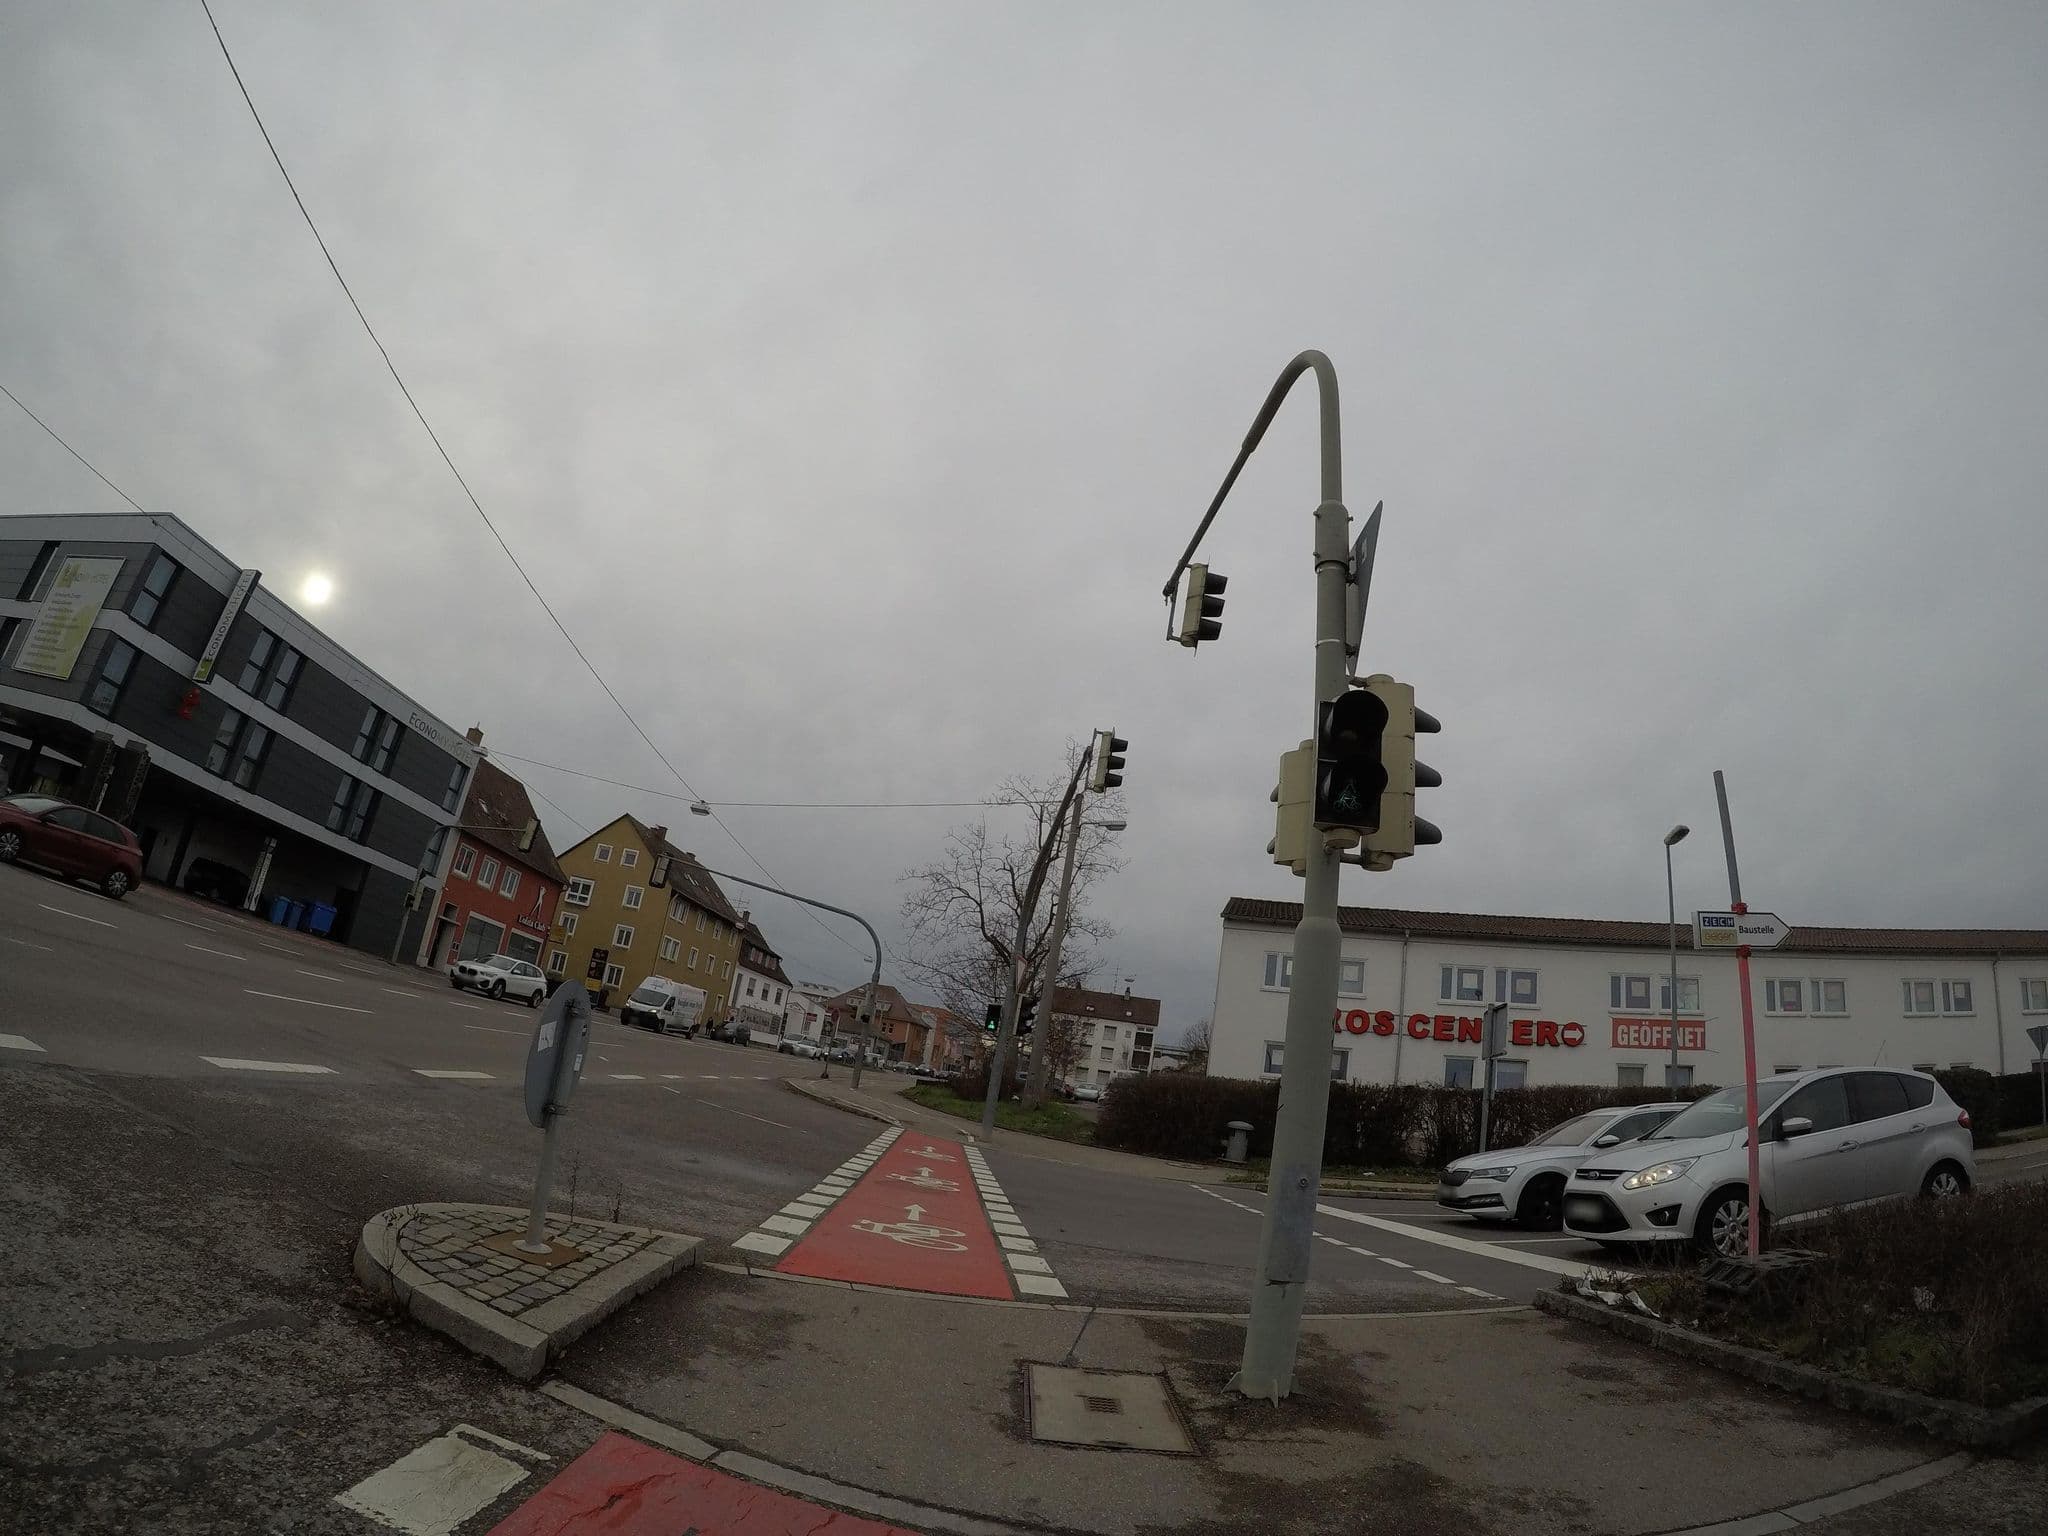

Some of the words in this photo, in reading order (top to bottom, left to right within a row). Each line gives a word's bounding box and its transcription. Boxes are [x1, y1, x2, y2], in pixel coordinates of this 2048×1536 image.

[1703, 917, 1735, 927] ZECH
[1738, 925, 1775, 937] Baustelle
[1407, 1014, 1559, 1047] CENER
[1616, 1019, 1705, 1047] GEÖFFNET
